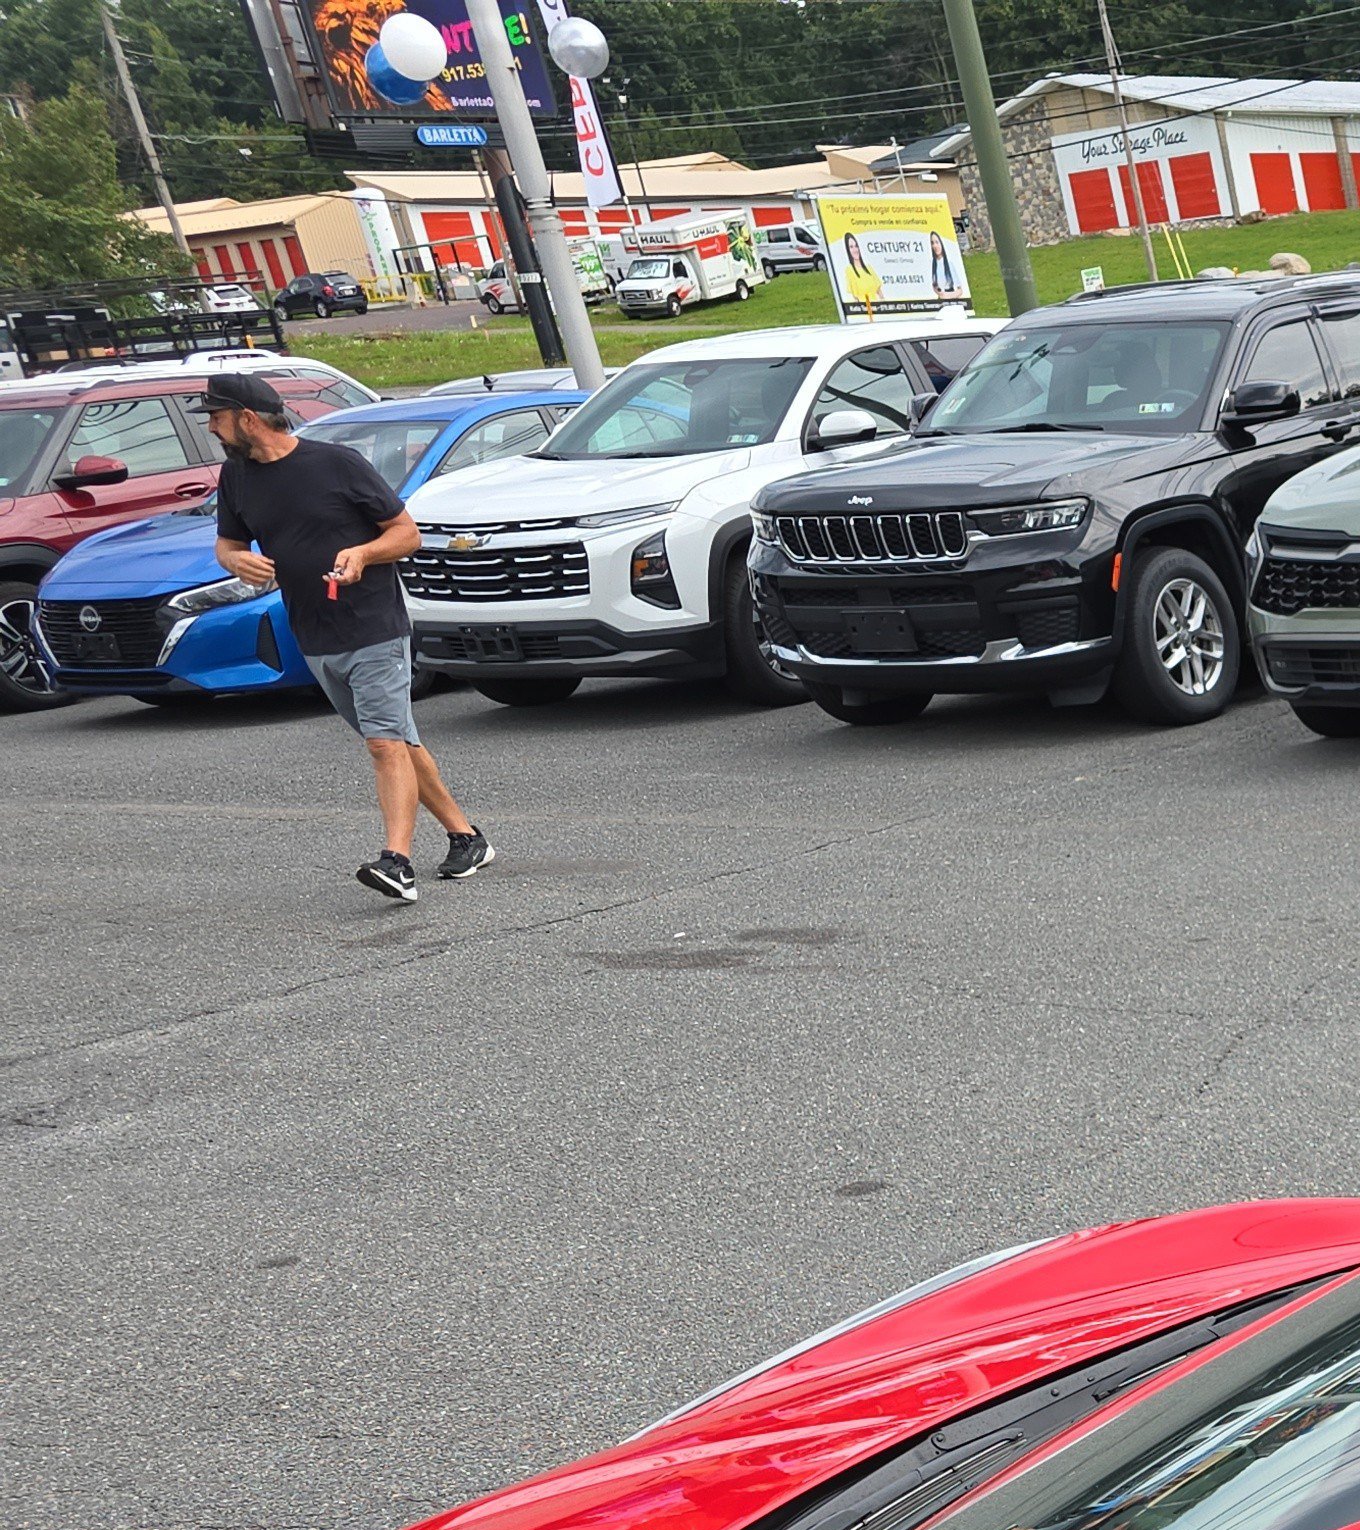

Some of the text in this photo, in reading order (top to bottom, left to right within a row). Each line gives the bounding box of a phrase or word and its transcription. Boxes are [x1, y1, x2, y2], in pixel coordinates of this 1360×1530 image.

[424, 126, 485, 145] BARLETTA
[1081, 140, 1110, 163] Your
[1152, 127, 1188, 148] Place
[867, 241, 925, 254] CENTURY 21
[847, 495, 874, 506] Jeep
